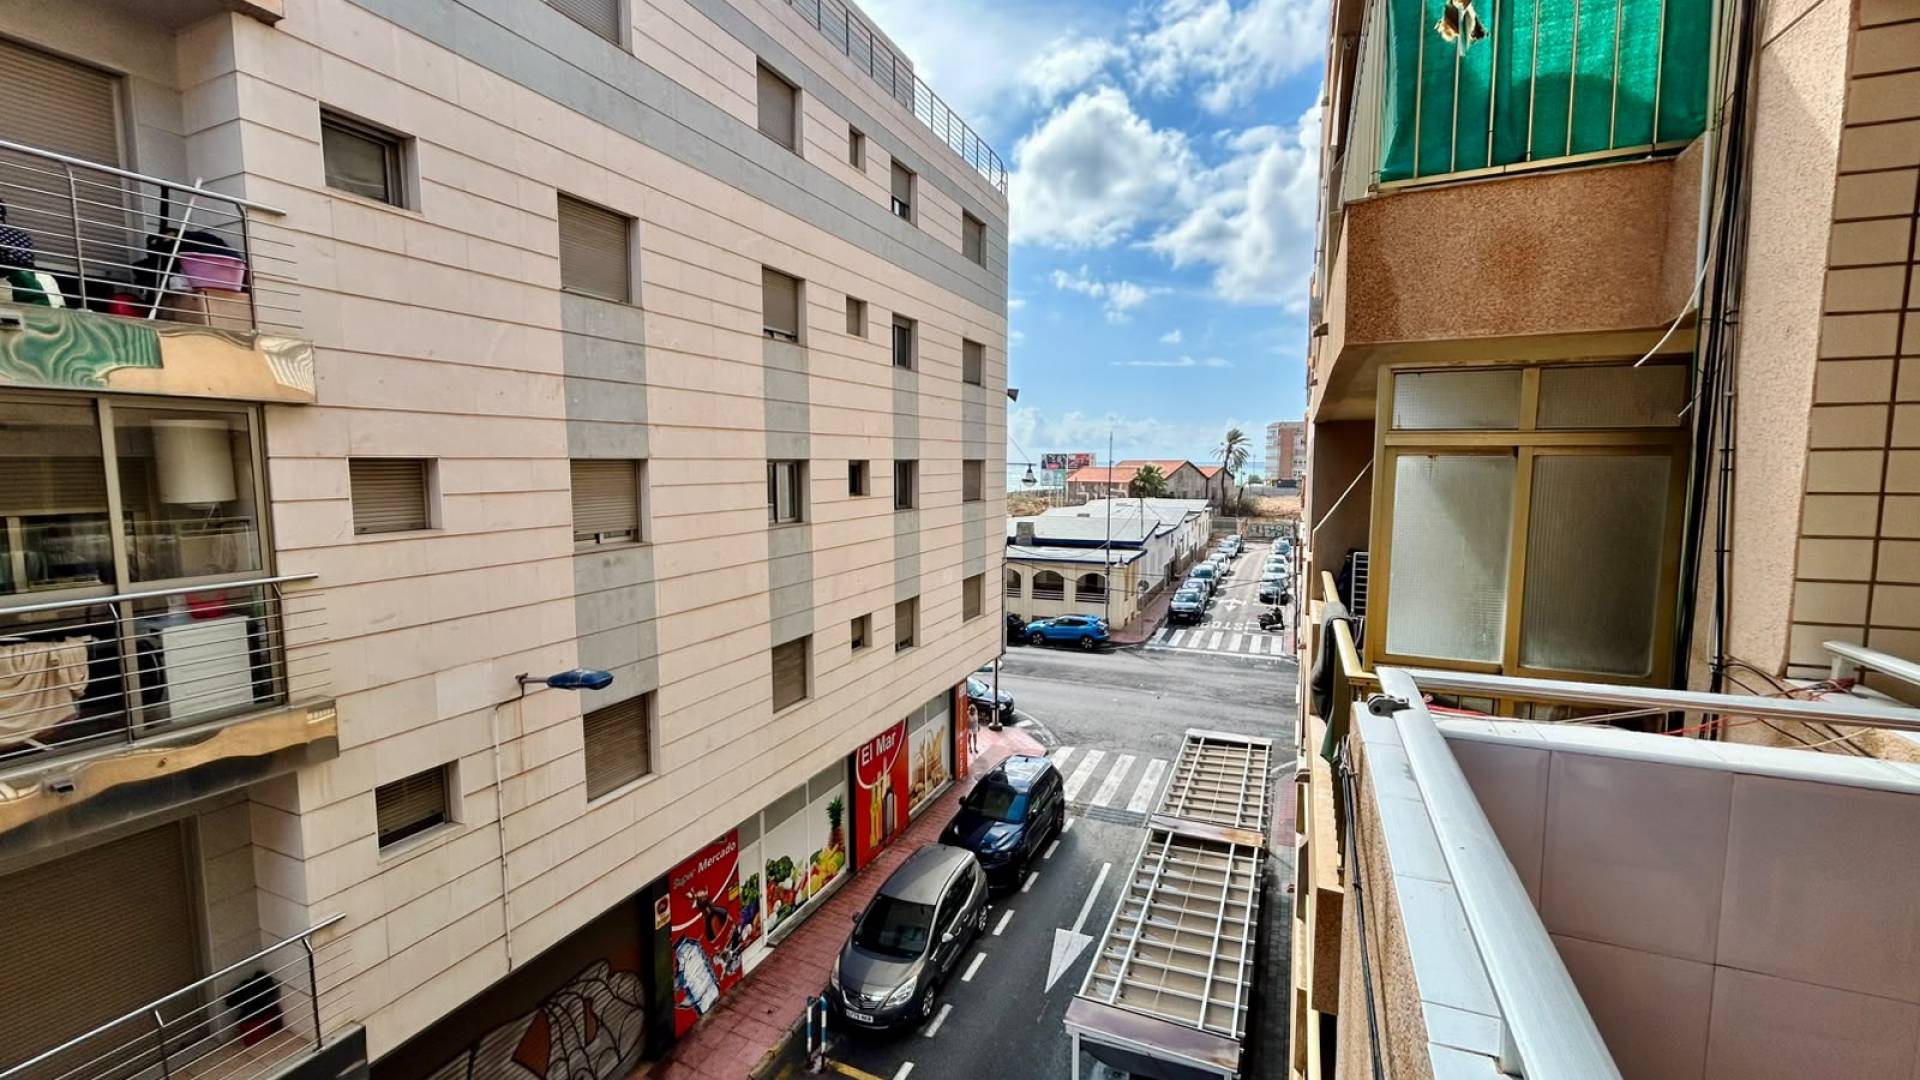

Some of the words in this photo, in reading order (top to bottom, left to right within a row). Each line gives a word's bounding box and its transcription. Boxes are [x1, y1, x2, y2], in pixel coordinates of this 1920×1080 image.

[861, 742, 873, 767] El
[876, 731, 896, 757] Mar
[698, 841, 736, 874] Mercado
